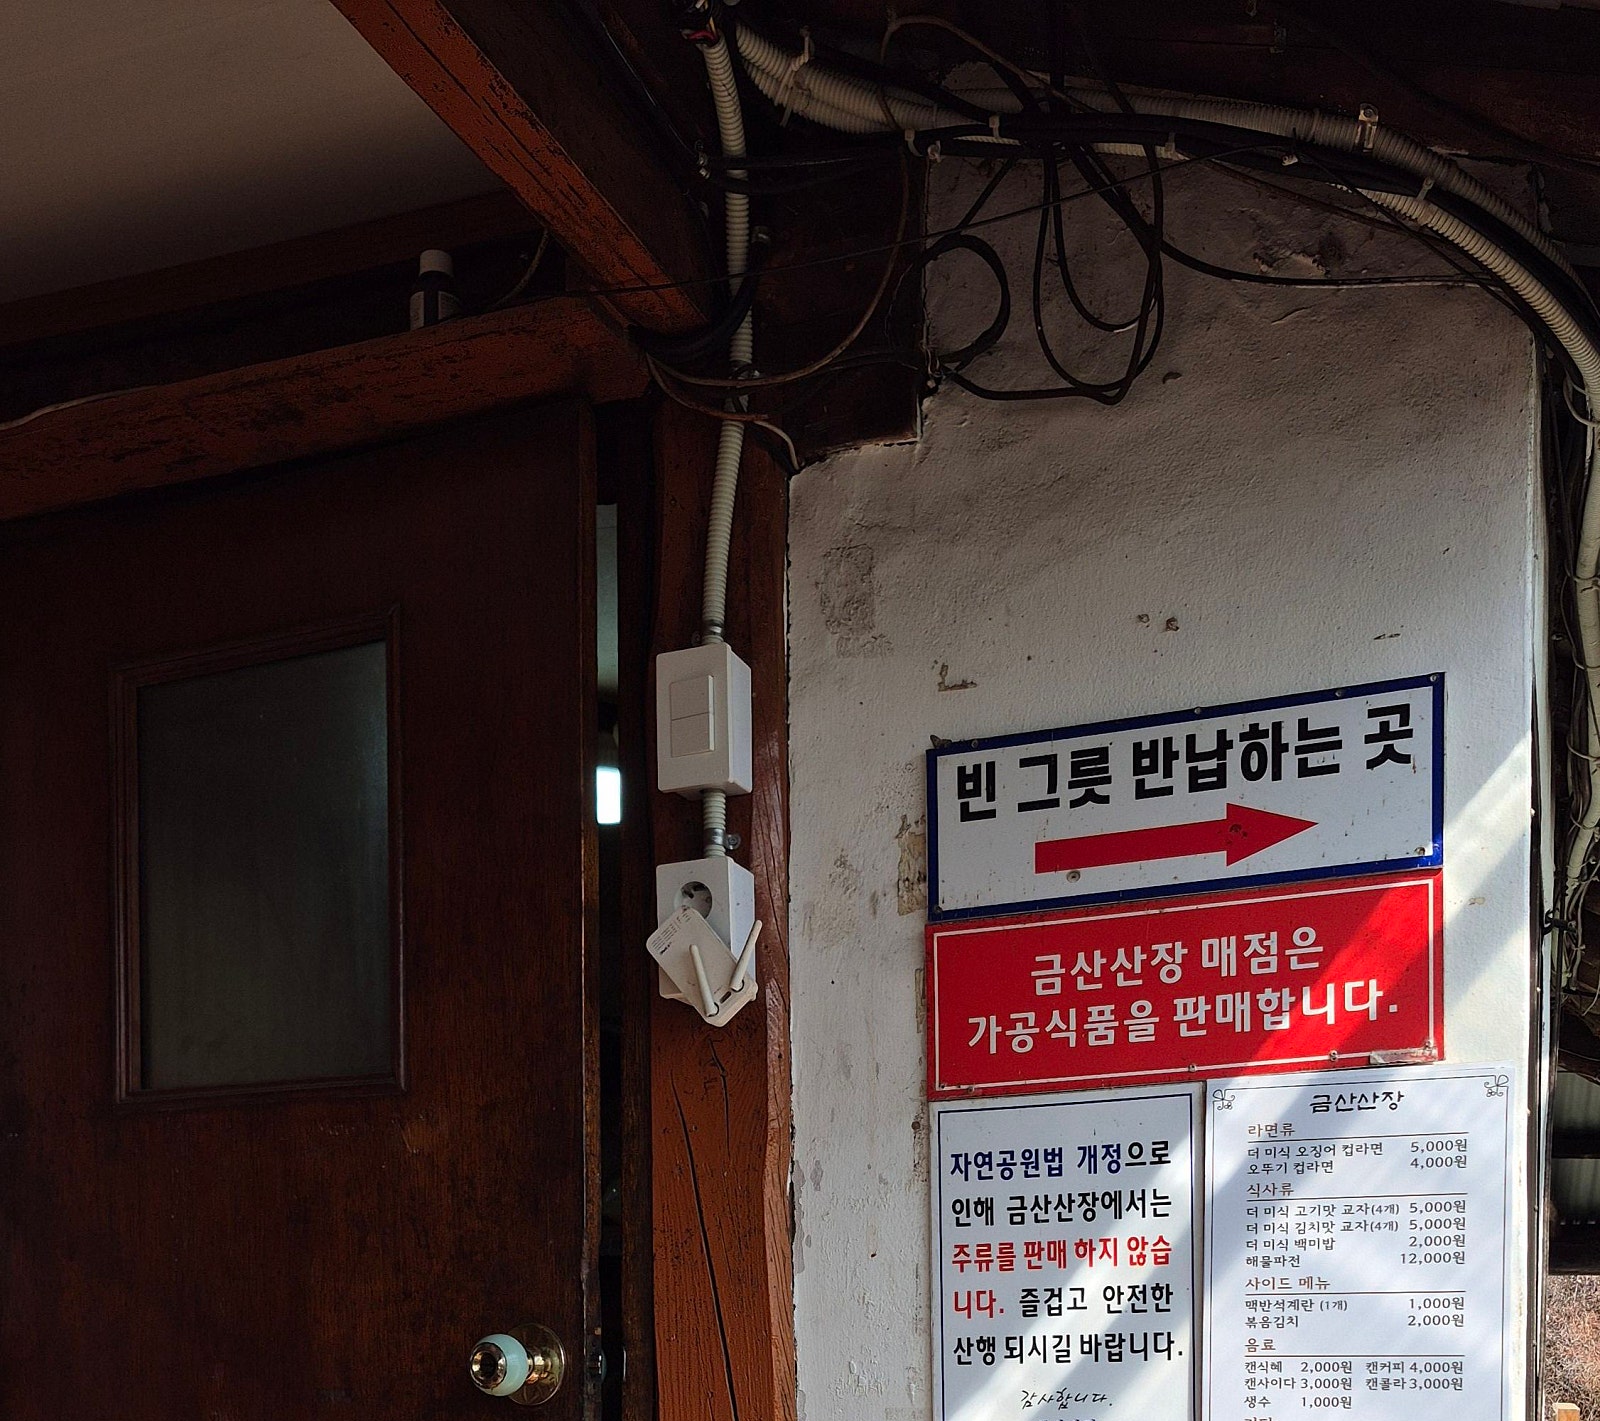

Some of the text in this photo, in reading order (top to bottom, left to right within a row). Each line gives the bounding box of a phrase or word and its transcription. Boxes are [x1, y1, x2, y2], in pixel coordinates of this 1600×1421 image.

[956, 703, 1415, 823] 빈 그릇 반납하는 곳
[1030, 926, 1324, 997] 금산산장 매점은
[967, 978, 1398, 1055] 가공식품을 판매합니다.
[1309, 1090, 1405, 1114] 금산산장
[1248, 1122, 1296, 1137] 라면류
[1247, 1138, 1468, 1160] 더 미식 오징어 컵라면 5,000원
[950, 1140, 1172, 1182] 자연공원법 개정으로
[1247, 1156, 1468, 1176] 오뚜기 컵라면 4,000원
[1246, 1182, 1295, 1198] 식사류
[951, 1188, 1172, 1227] 인해 금산산장에서는
[1247, 1200, 1466, 1218] 더 미식 고기맛 교자(4개) 5,000원
[1246, 1217, 1466, 1235] 더 미식 김치맛 교자(4개) 5,000원
[1246, 1234, 1466, 1251] 더 미식 백미밥 2,000원
[951, 1234, 1173, 1273] 주류를 판매 하지 않습
[1246, 1251, 1466, 1268] 해물파전 12,000원
[1245, 1276, 1331, 1291] 사이드 메뉴
[953, 1282, 1174, 1319] 니다. 즐겁고 안전한
[1245, 1296, 1465, 1313] 맥반석계란 (1개) 1,000원
[1245, 1313, 1465, 1329] 볶음김치 2,000원
[953, 1330, 1183, 1367] 산행 되시길 바랍니다.
[1245, 1338, 1276, 1352] 음료
[1244, 1360, 1352, 1374] 캔식혜 2,000원
[1365, 1360, 1464, 1375] 캔커피 4,000원
[1244, 1377, 1352, 1391] 캔사이다 3,000원
[1365, 1377, 1464, 1391] 캔콜라 3,000원
[1020, 1388, 1113, 1411] 감사합니다.
[1244, 1395, 1352, 1409] 생수 1,000원
